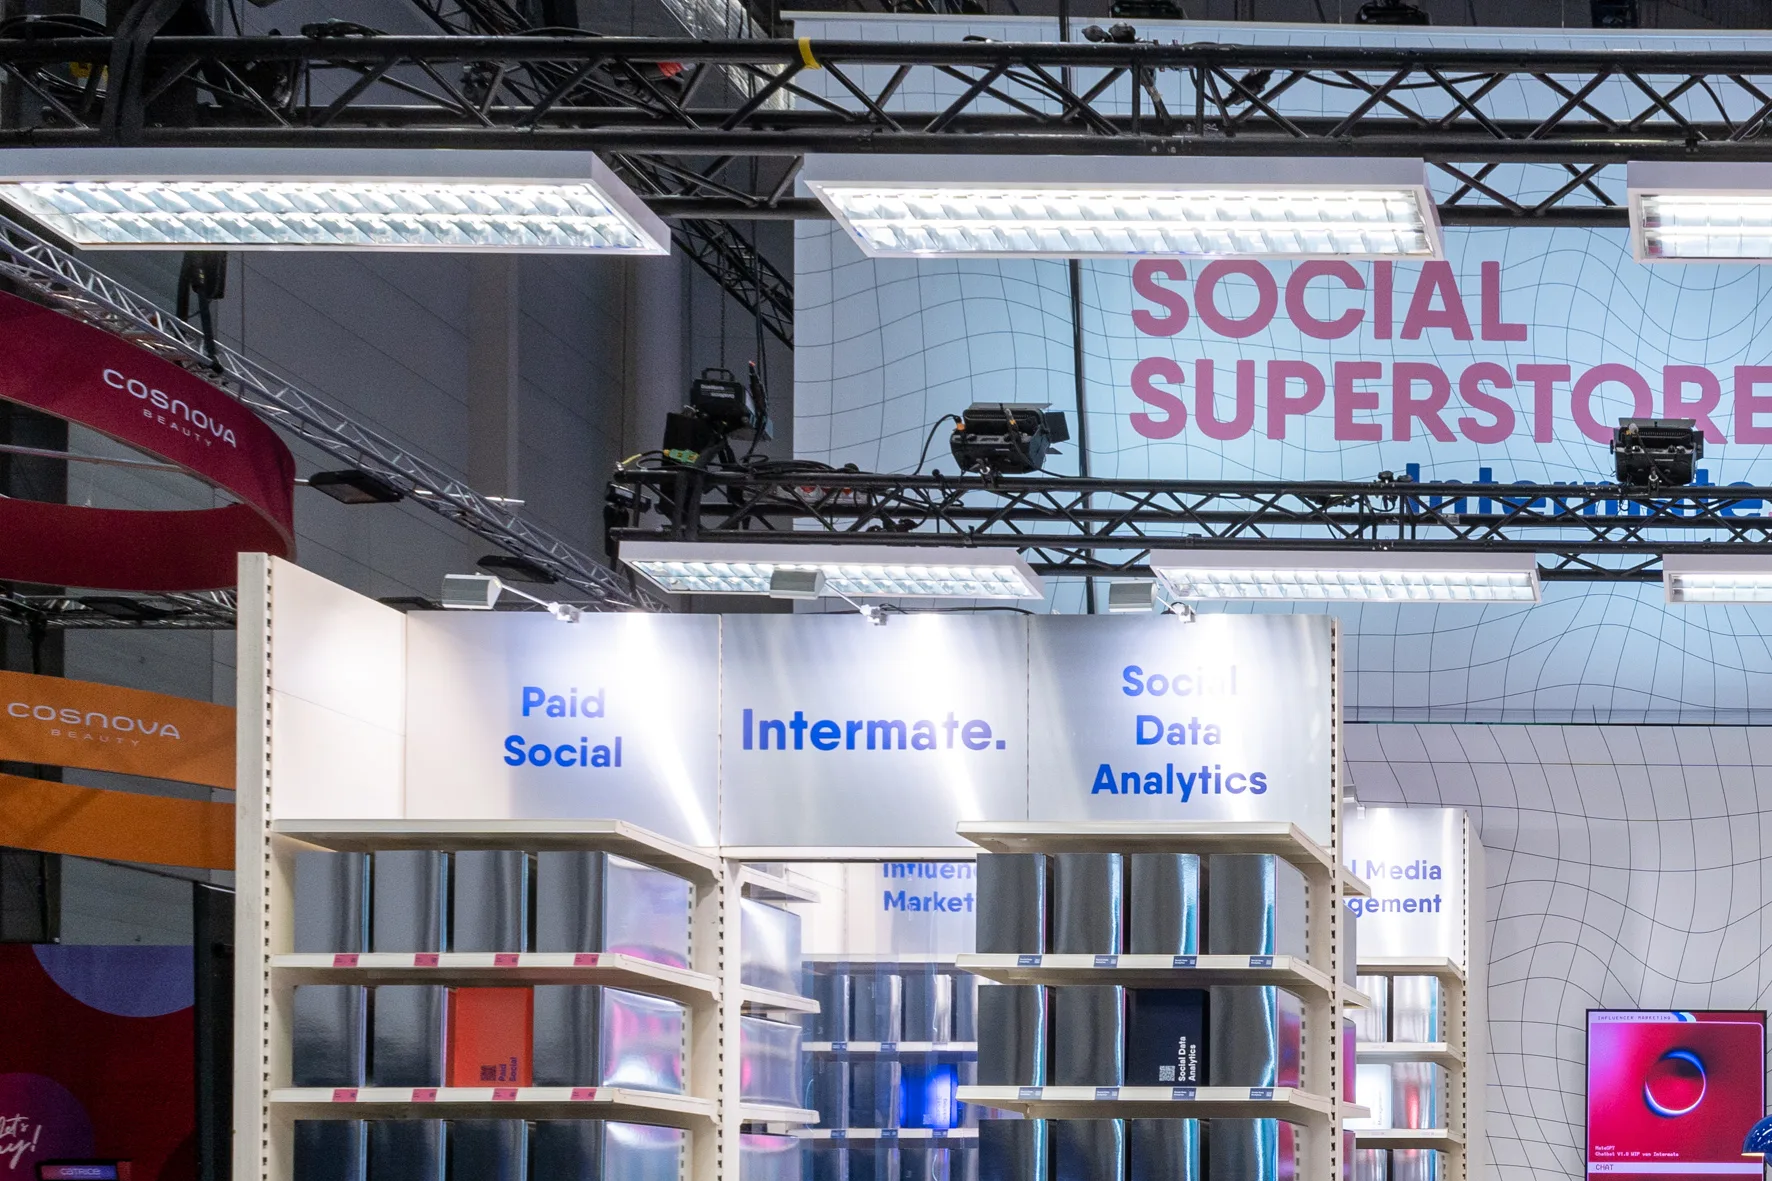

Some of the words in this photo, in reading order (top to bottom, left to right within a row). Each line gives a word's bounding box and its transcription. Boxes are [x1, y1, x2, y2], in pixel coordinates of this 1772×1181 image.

[1133, 259, 1526, 340] SOCIAL
[103, 368, 237, 448] COSNOVA
[143, 409, 212, 447] BEAUTY
[1122, 664, 1238, 697] Socil
[521, 686, 605, 718] Paid
[7, 702, 181, 740] COSNOVA
[742, 708, 1007, 752] Intermate.
[1136, 714, 1222, 746] Data
[51, 729, 140, 747] BEAUTY
[504, 733, 622, 769] Social
[1091, 763, 1268, 803] Analytics
[1366, 859, 1442, 880] Media
[883, 890, 974, 913] Market
[1344, 894, 1442, 919] gement
[1178, 1036, 1187, 1056] Data
[1178, 1057, 1187, 1082] Social
[1188, 1044, 1197, 1082] Analytics
[1595, 1163, 1615, 1171] CHAT
